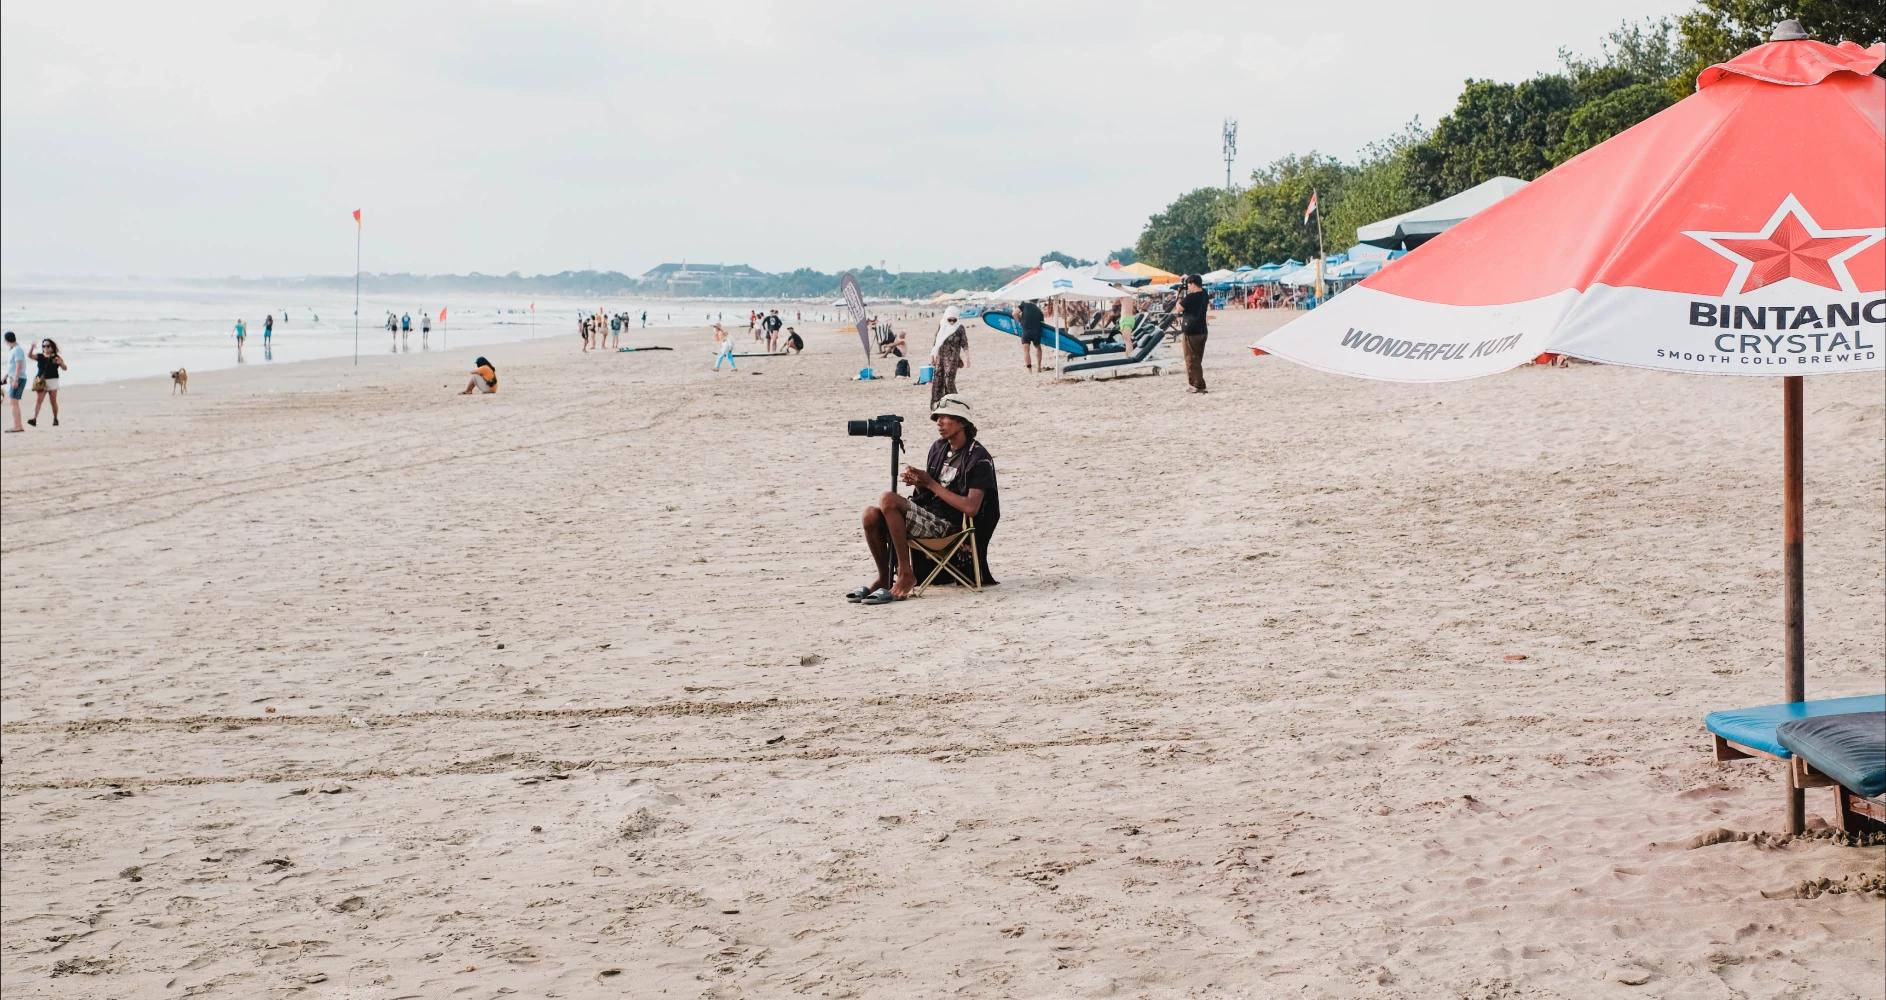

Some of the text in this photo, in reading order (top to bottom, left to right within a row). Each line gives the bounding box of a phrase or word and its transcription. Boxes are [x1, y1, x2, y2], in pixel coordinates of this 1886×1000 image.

[1341, 328, 1523, 360] WONDERFUL KUTA
[1715, 331, 1873, 353] CRYSTAL
[1657, 350, 1730, 364] SMOOTH
[1799, 352, 1875, 364] BREWED
